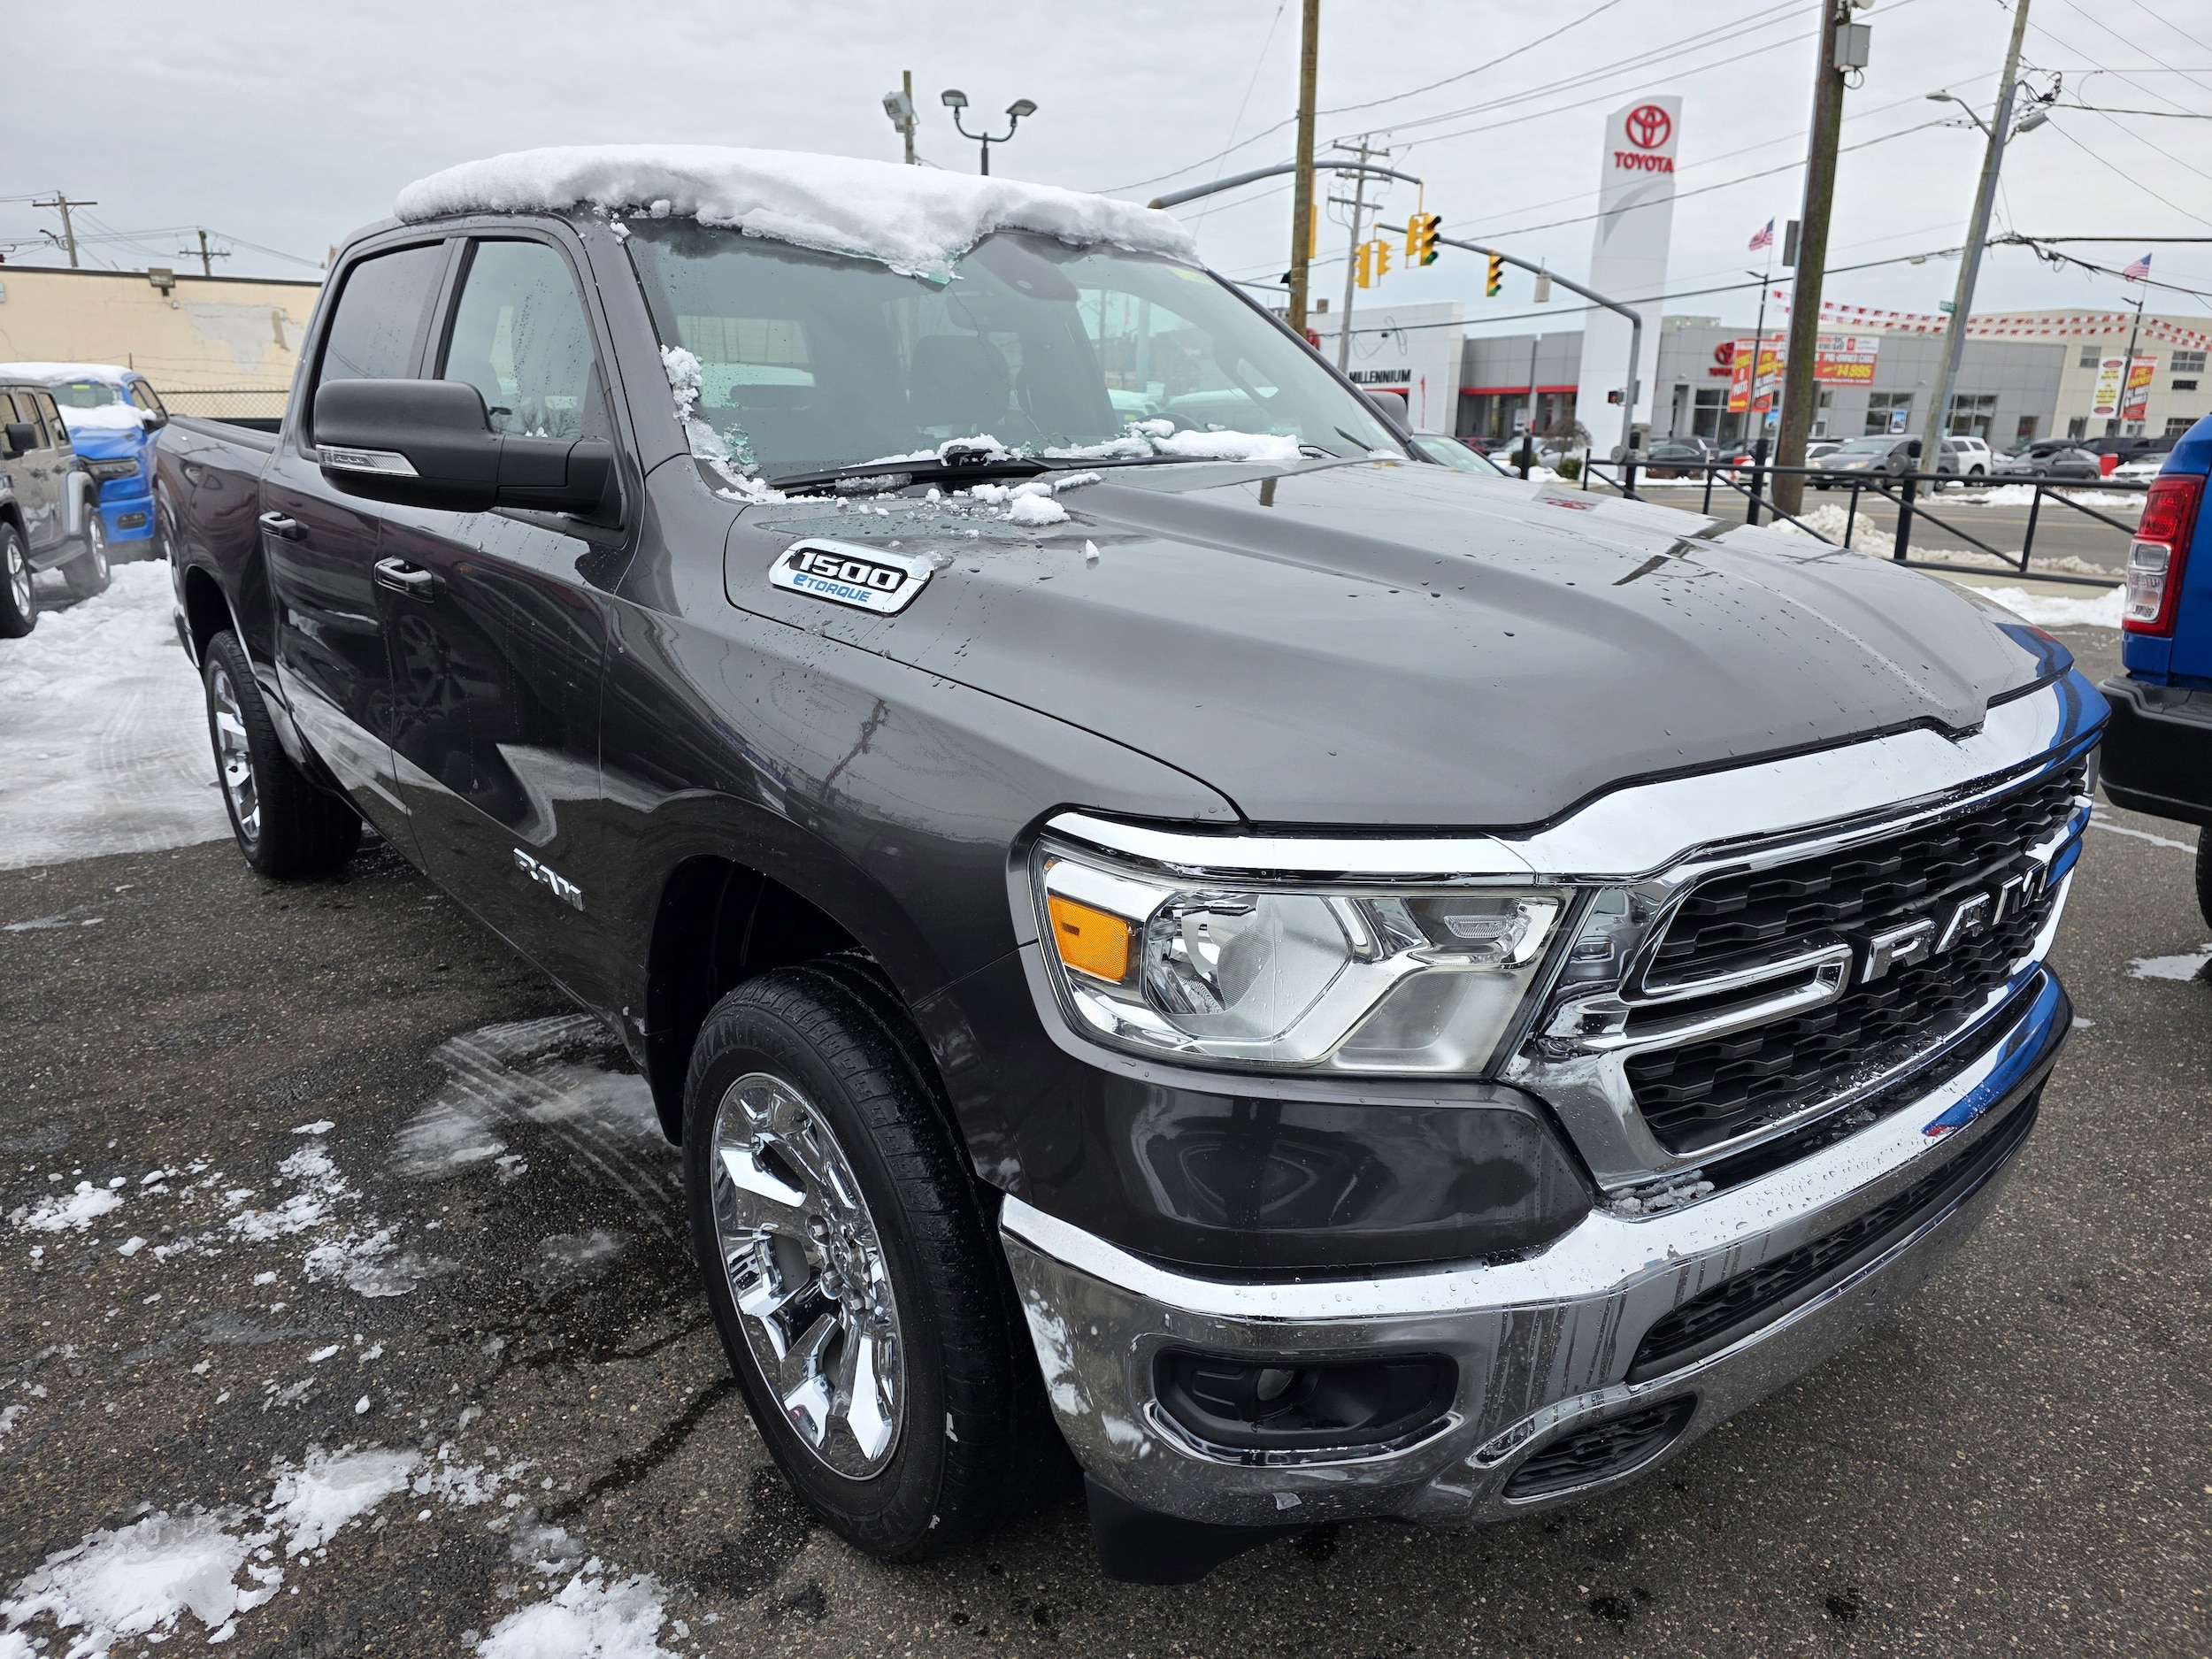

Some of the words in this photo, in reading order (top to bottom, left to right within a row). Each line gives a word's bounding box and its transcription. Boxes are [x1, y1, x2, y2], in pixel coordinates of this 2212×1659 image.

[1614, 151, 1674, 173] TOYOTA
[1348, 369, 1411, 384] MILLENNIUM
[800, 551, 902, 591] 1500
[513, 847, 584, 912] RAM
[1861, 860, 2047, 985] RAM
